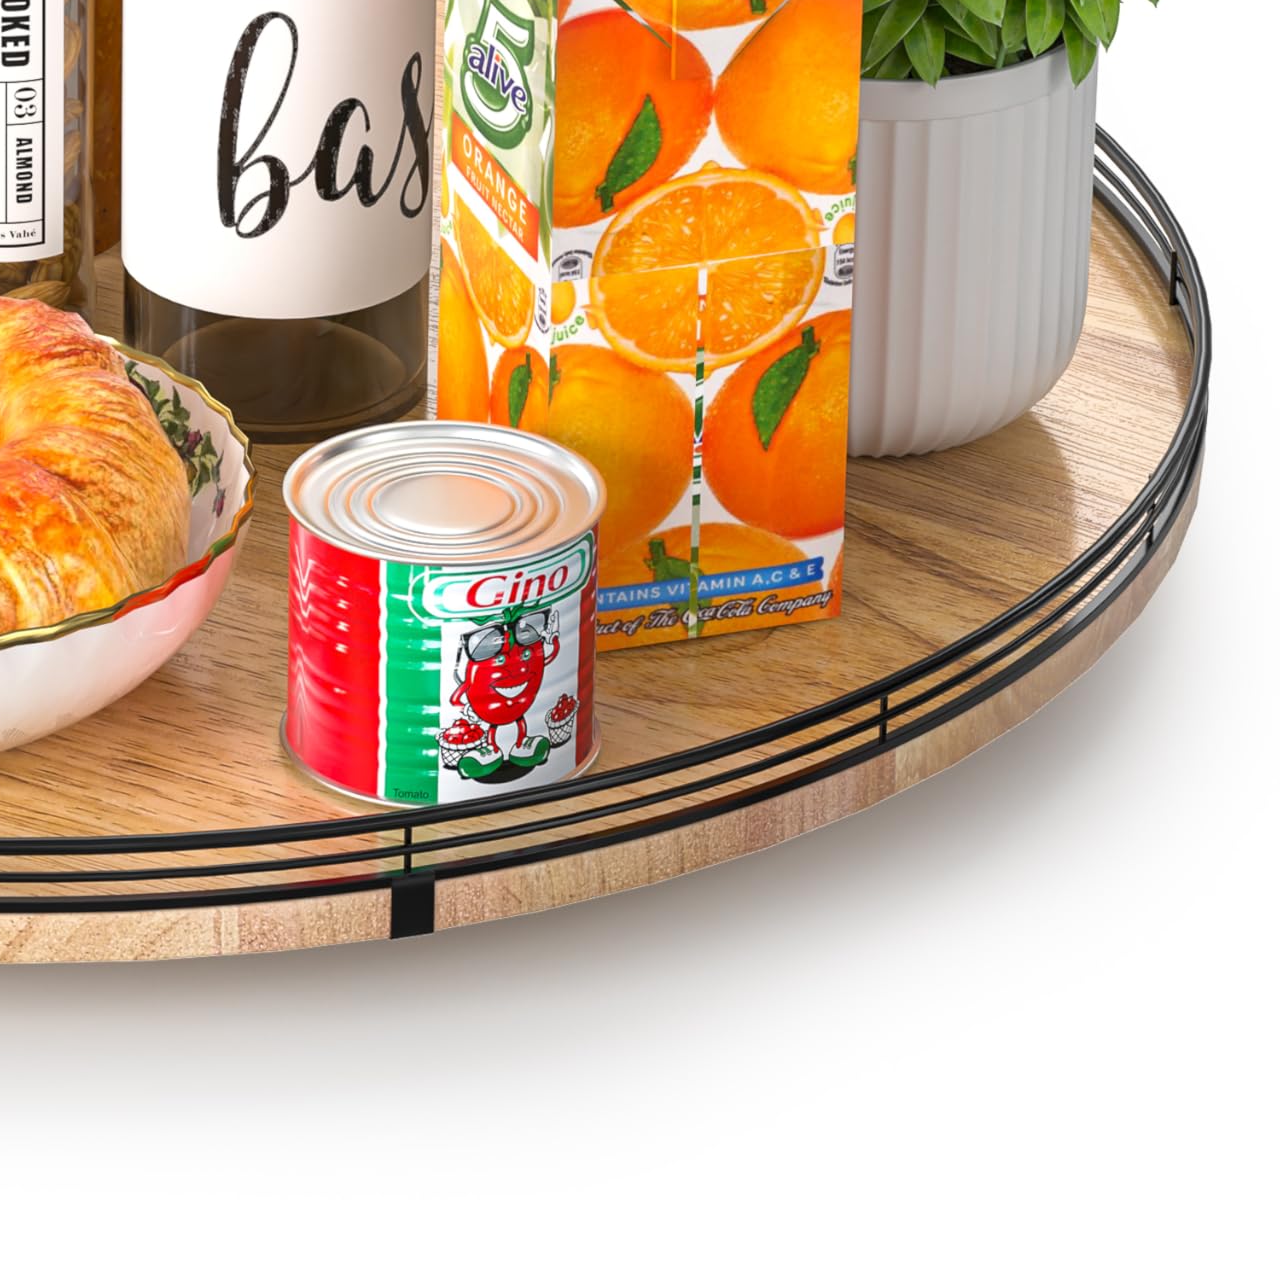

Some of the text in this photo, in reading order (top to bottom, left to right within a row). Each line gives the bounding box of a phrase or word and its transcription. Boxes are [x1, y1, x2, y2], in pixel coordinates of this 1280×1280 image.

[468, 44, 527, 113] alive
[14, 87, 37, 118] 03
[16, 138, 33, 204] ALMOND
[463, 133, 527, 225] ORANGE
[466, 166, 524, 241] FRUIT NECTAR
[9, 228, 37, 238] Vahé
[551, 316, 584, 345] juice
[466, 565, 569, 609] Gino
[597, 587, 660, 604] NTAINS
[667, 575, 745, 595] VIAMIN
[789, 568, 800, 580] &
[807, 564, 816, 576] E
[758, 589, 832, 616] Company
[393, 788, 430, 799] Tomato
